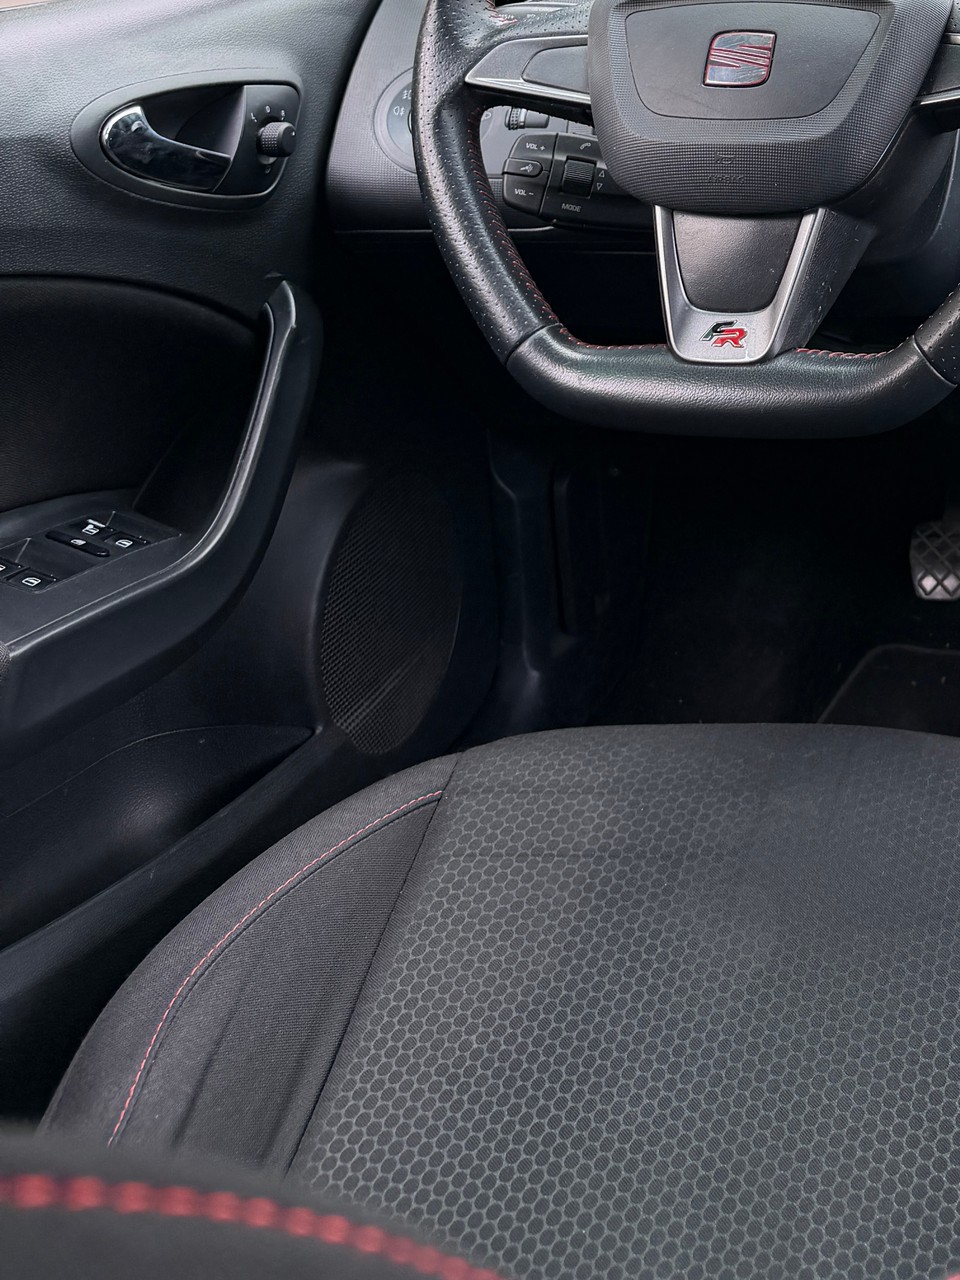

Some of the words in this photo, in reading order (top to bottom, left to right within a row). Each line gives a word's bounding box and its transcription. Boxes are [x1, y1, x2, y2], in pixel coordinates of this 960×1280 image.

[525, 142, 538, 150] VOL
[514, 188, 527, 196] VOL
[561, 203, 582, 213] MODE
[699, 320, 748, 348] FR
